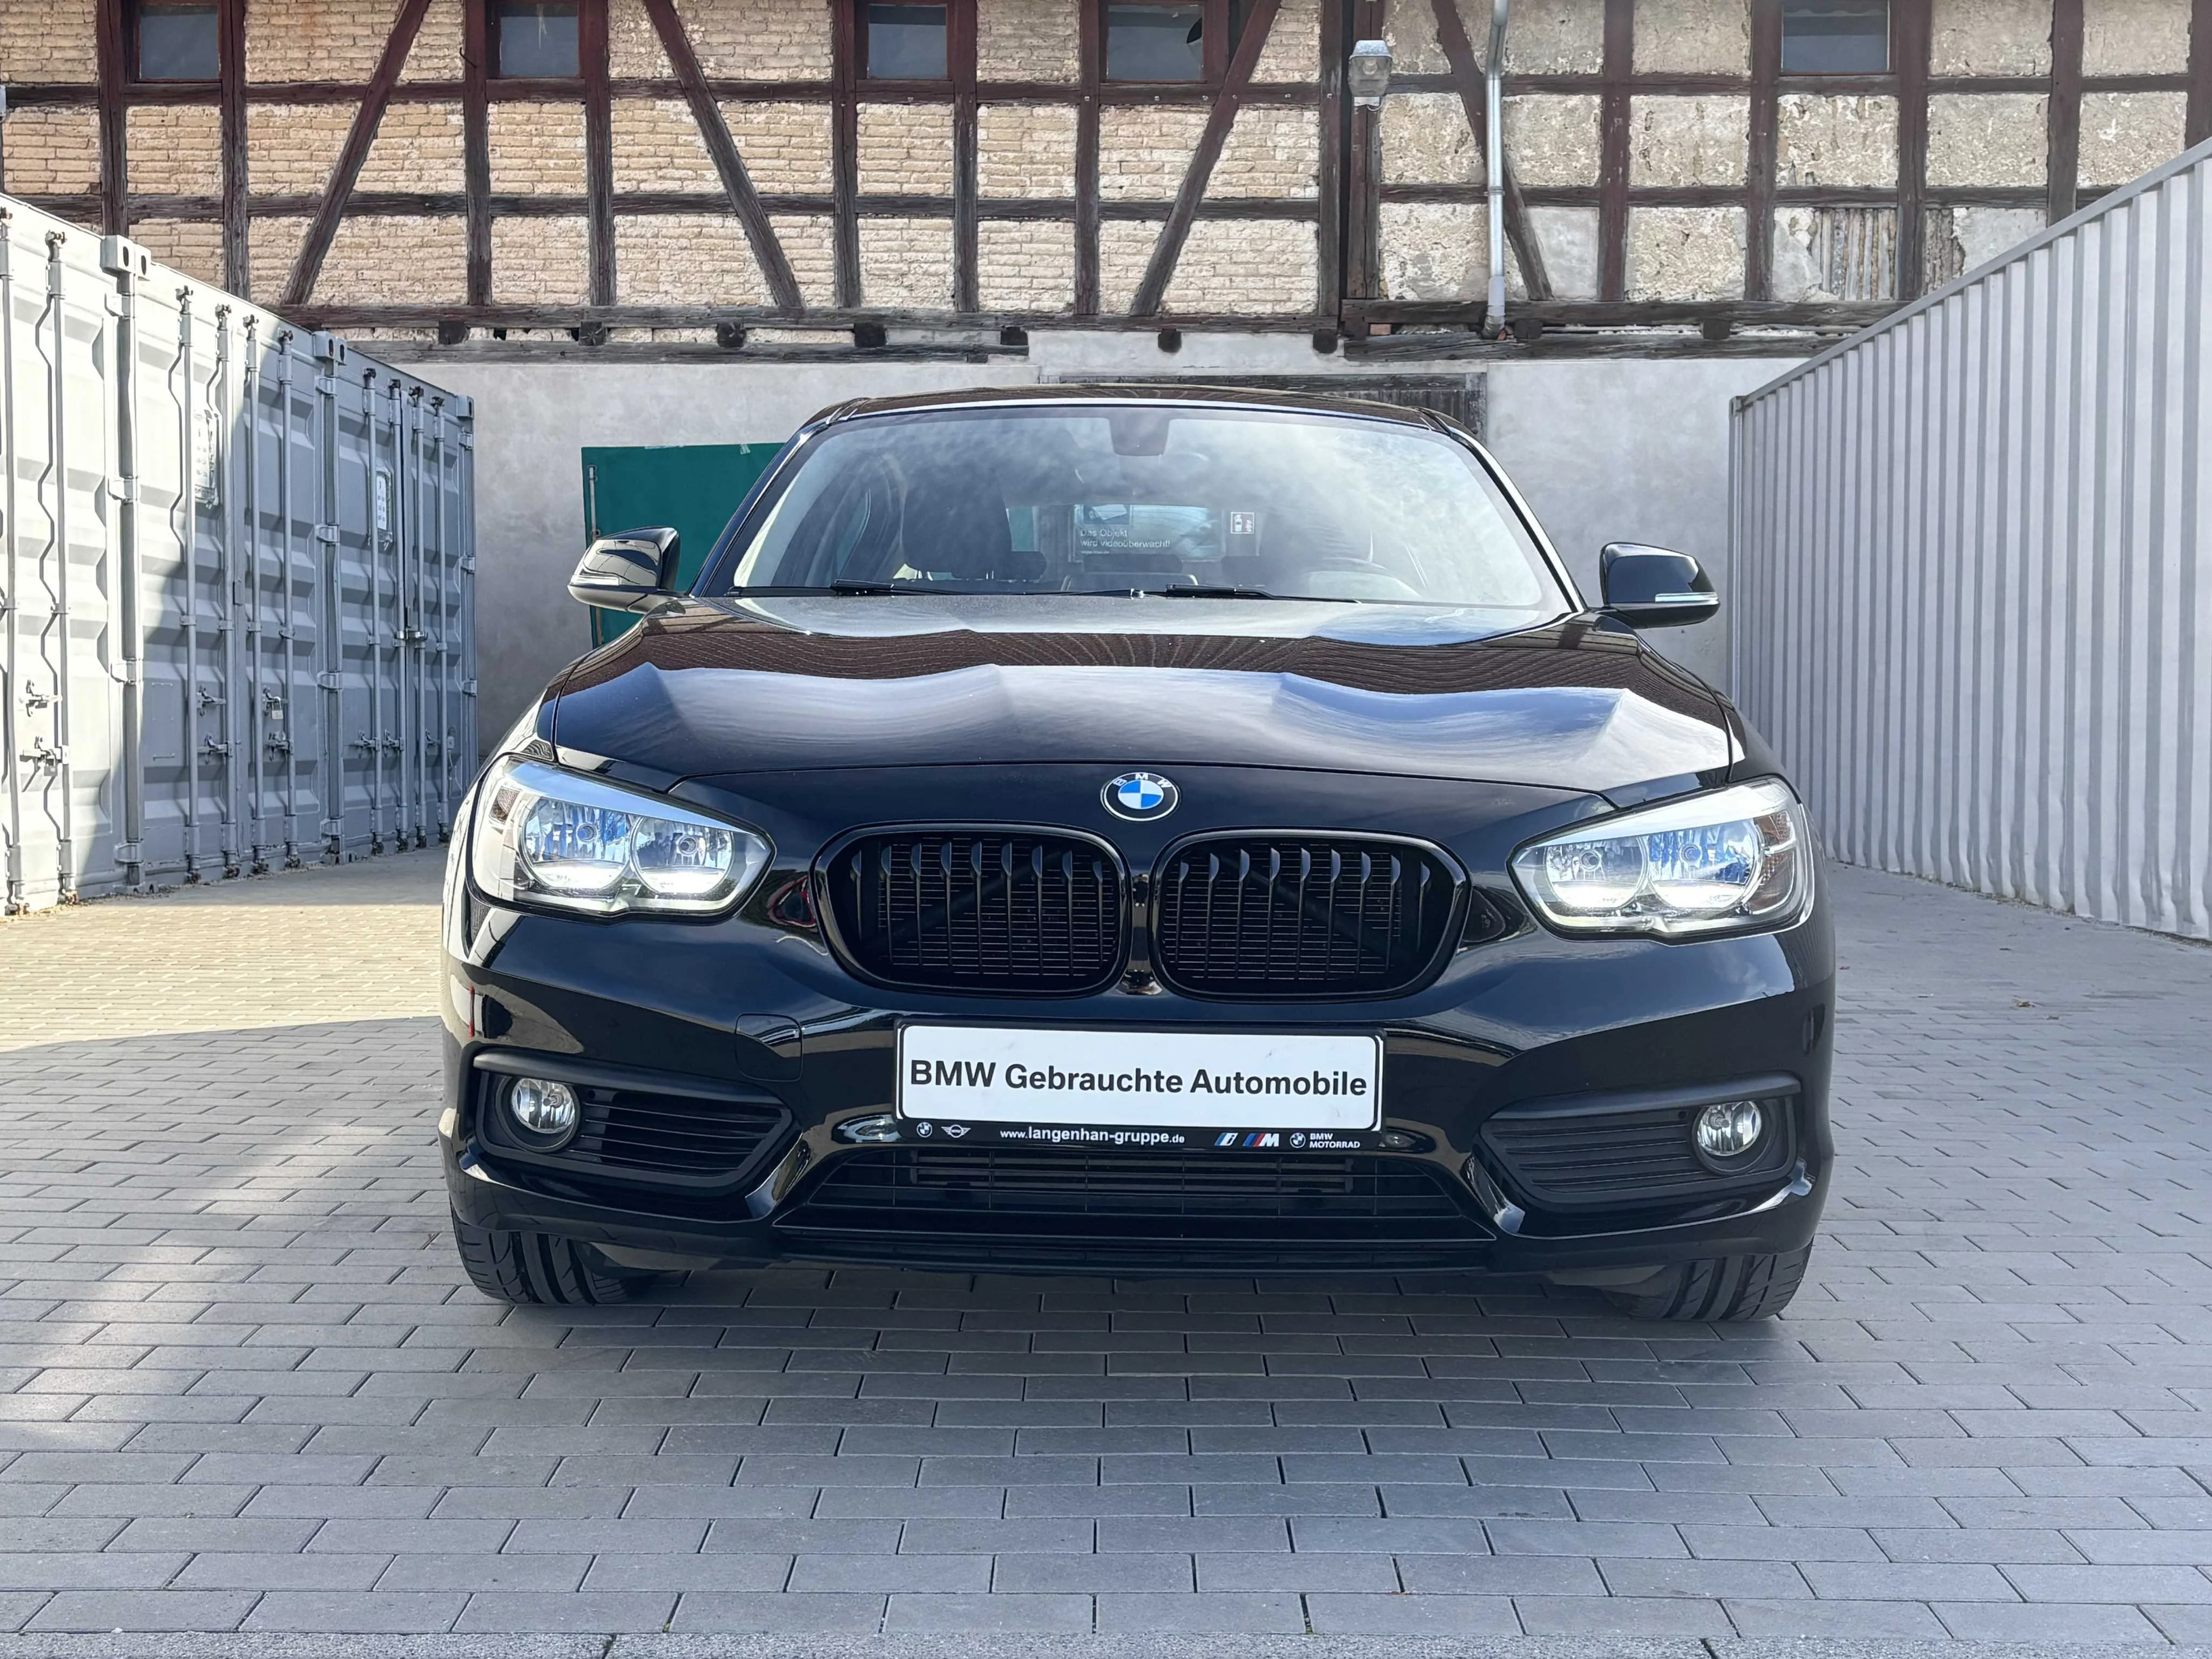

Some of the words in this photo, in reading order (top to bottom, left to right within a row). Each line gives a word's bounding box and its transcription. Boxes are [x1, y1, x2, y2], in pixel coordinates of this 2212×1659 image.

[1081, 529, 1097, 537] Das
[1100, 528, 1128, 540] Objekt
[1081, 539, 1098, 547] wird
[1112, 772, 1173, 788] BMW
[911, 1060, 996, 1087] BMW
[1005, 1063, 1183, 1094] Gebrauchte
[1190, 1069, 1367, 1096] Automobile
[1000, 1126, 1185, 1145] www.langenhan-gruppe.de
[1309, 1141, 1361, 1149] MOTORRAD
